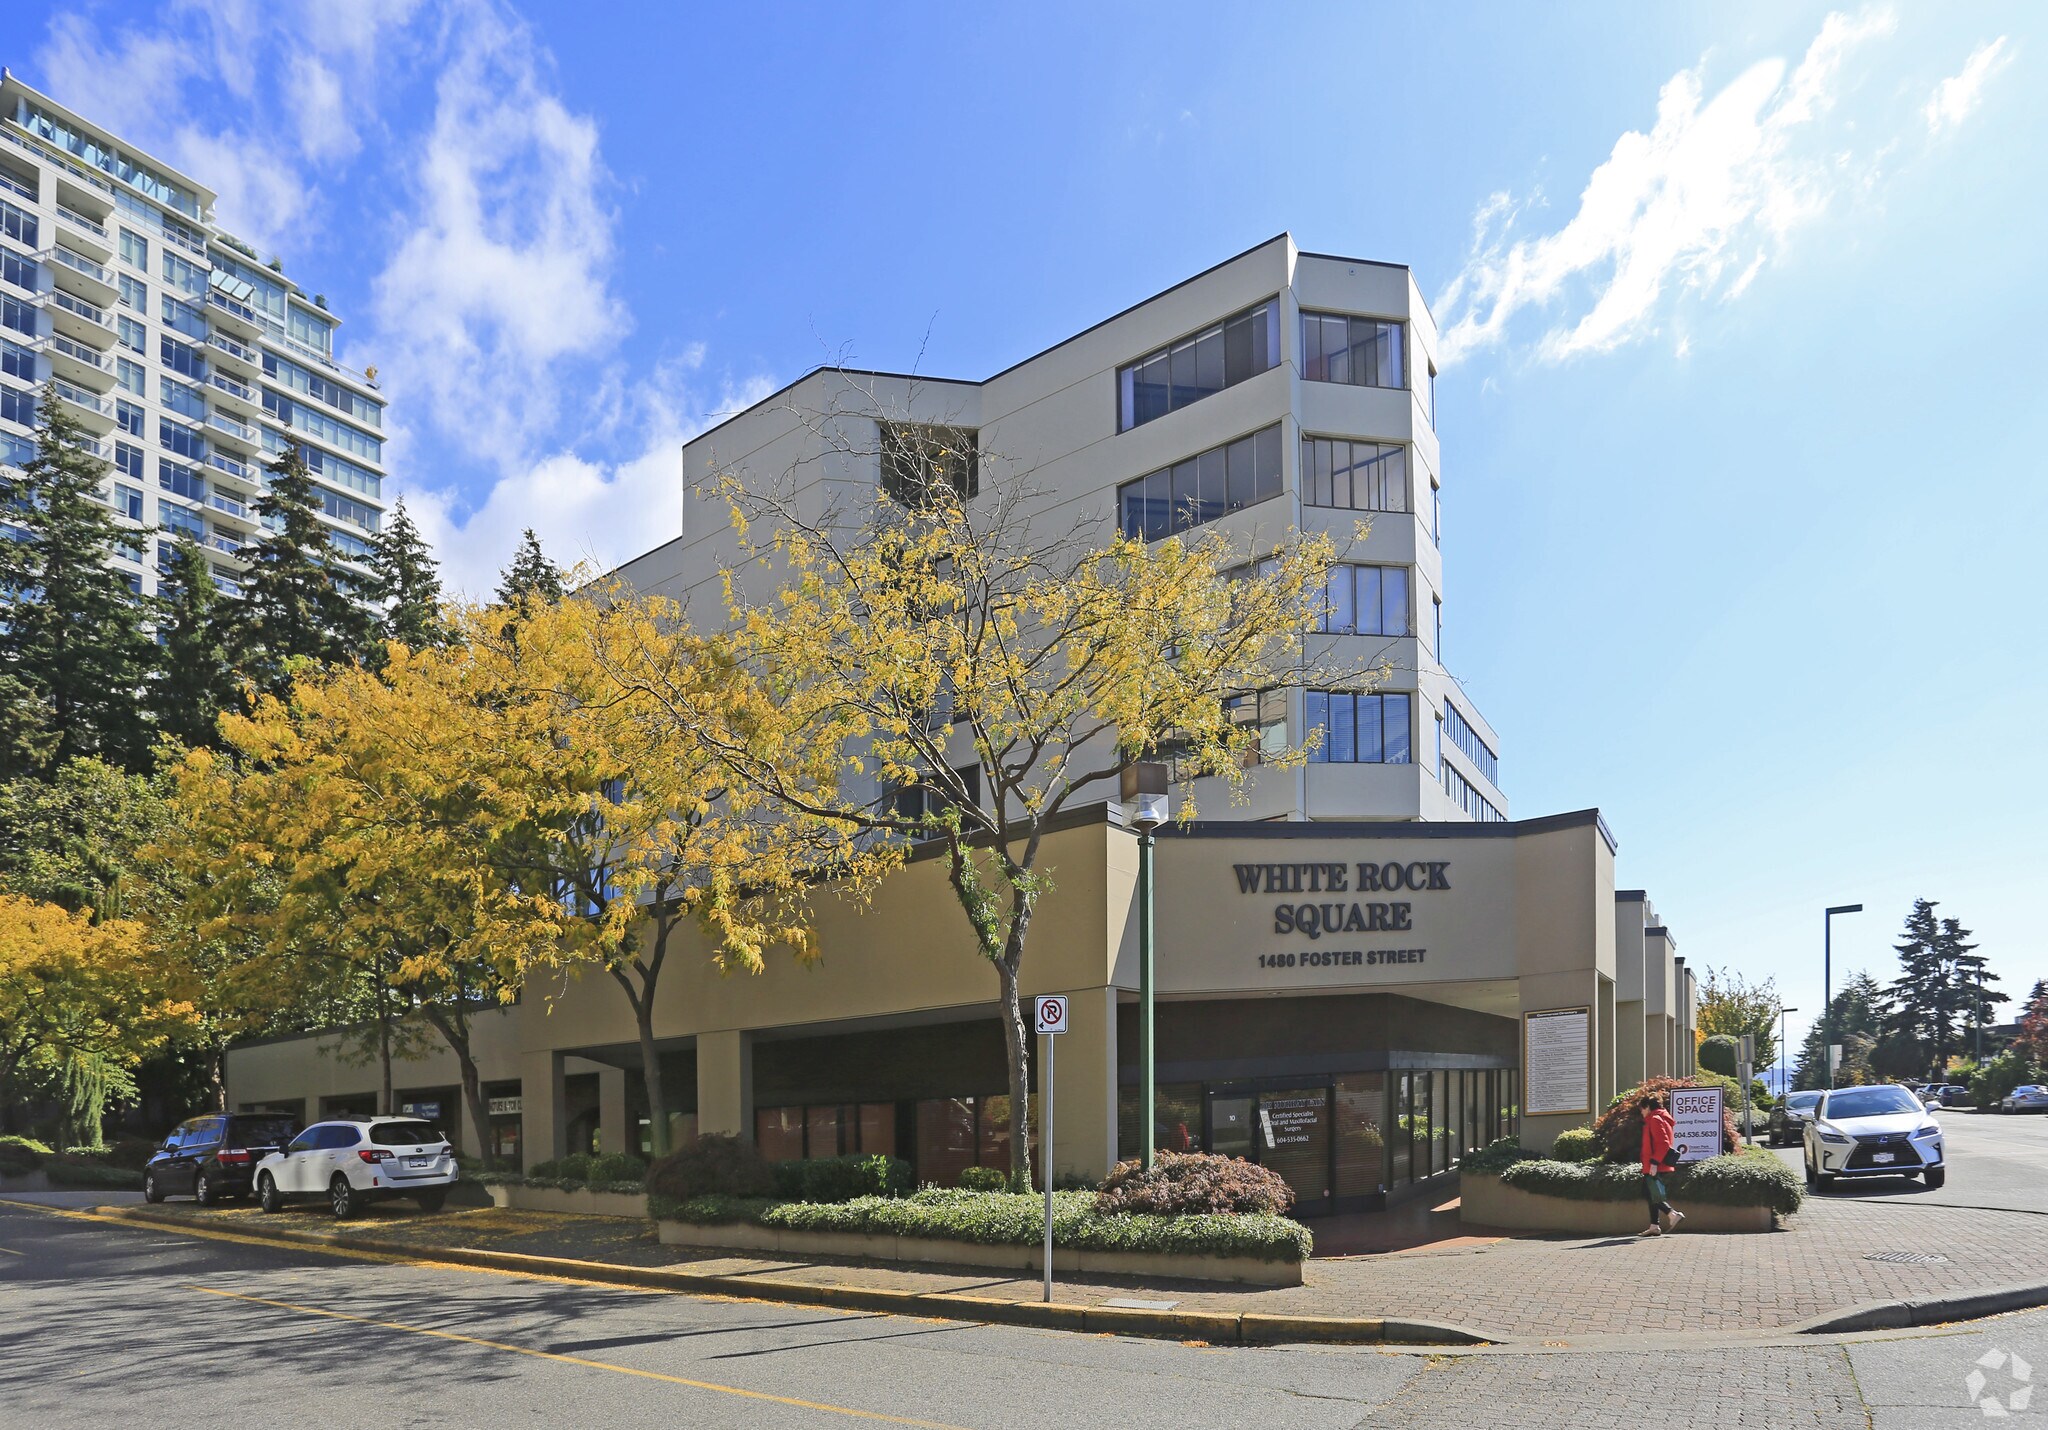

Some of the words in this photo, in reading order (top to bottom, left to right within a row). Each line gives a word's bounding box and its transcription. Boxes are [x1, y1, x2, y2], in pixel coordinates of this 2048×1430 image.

[1233, 862, 1348, 894] WHITE
[1356, 861, 1451, 892] ROCK
[1274, 902, 1412, 940] SQUARE
[1258, 953, 1296, 968] 1480
[1300, 951, 1363, 967] FOSTER
[1367, 949, 1427, 965] STREET
[1676, 1096, 1716, 1106] OFFICE
[1677, 1105, 1714, 1114] SPACE
[1292, 1111, 1314, 1119] Specialist
[1289, 1117, 1318, 1125] Maxillofacial
[1276, 1135, 1309, 1144] 604-535-0662
